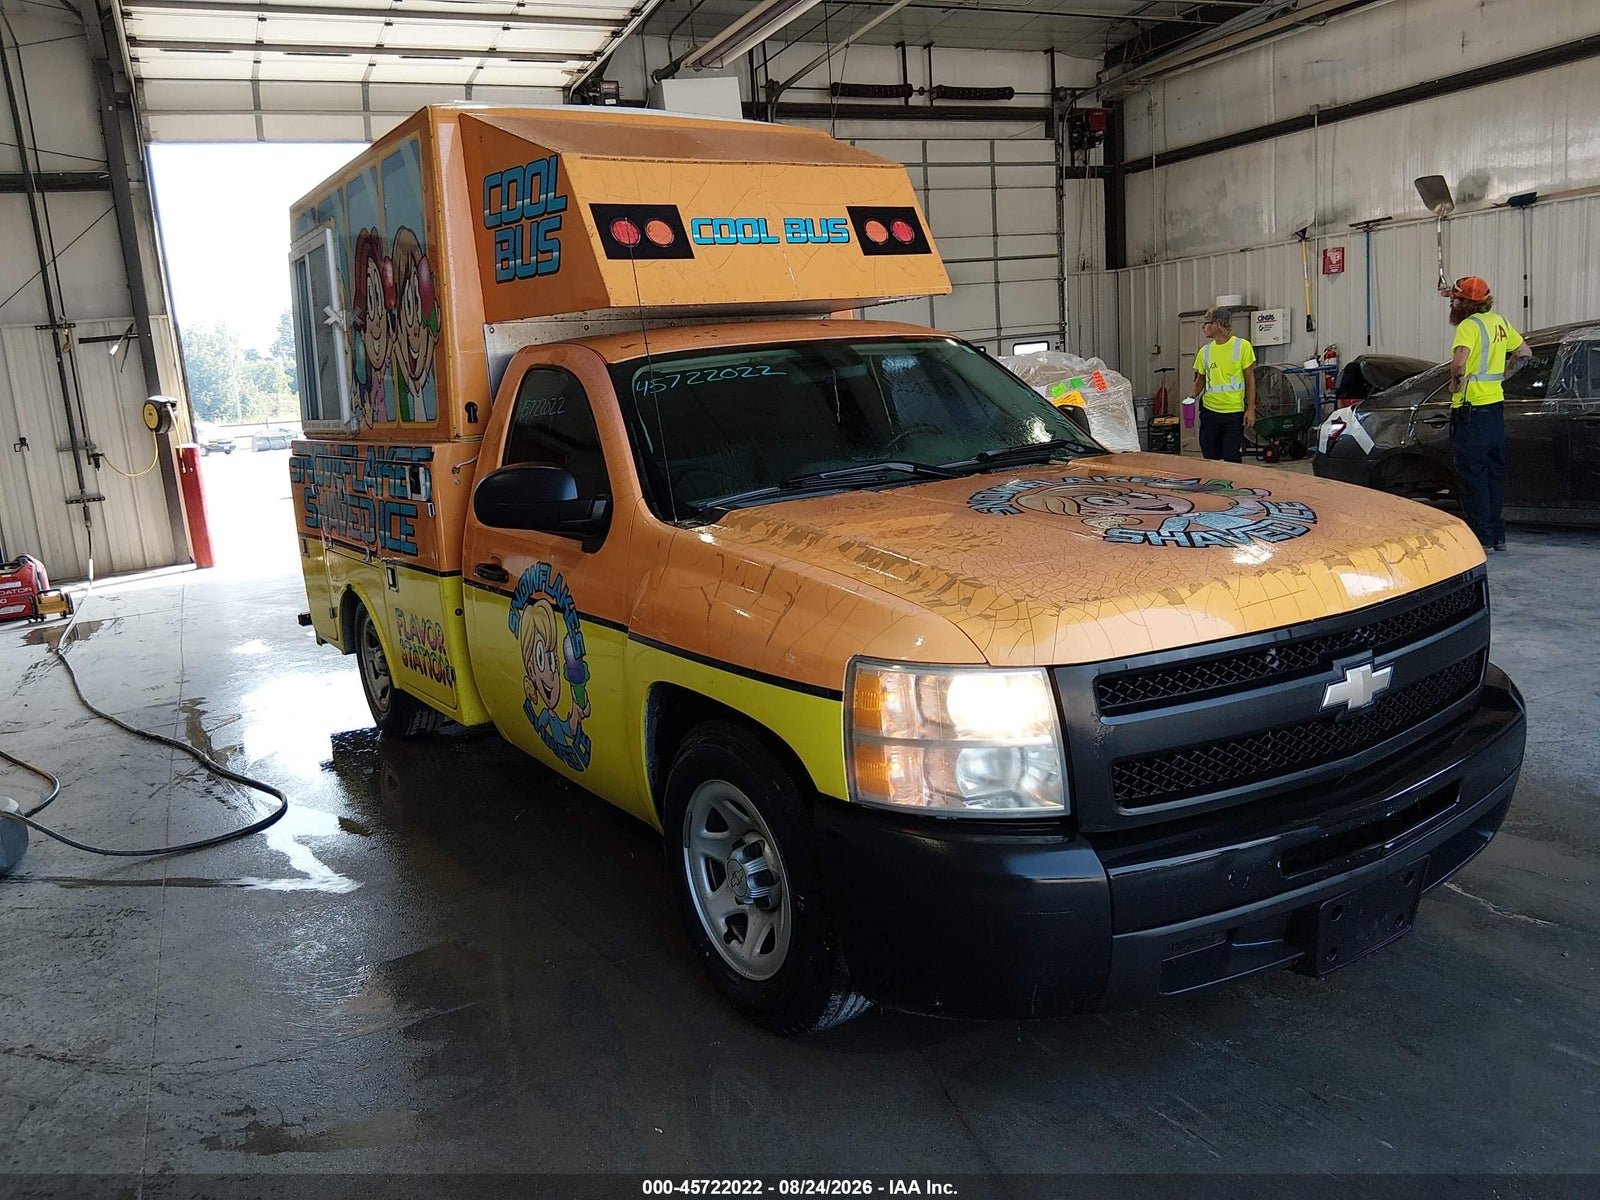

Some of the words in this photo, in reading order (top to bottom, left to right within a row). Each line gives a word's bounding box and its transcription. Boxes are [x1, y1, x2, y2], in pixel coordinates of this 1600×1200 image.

[482, 153, 569, 230] COOL
[494, 214, 563, 284] BUS
[690, 216, 781, 247] COOL
[783, 217, 851, 245] BUS
[635, 365, 788, 397] 45722022
[304, 487, 377, 546] SHAVED
[378, 501, 419, 558] ICE
[1103, 518, 1311, 548] SHAVED
[395, 607, 447, 655] FLAVOR
[508, 560, 587, 660] SNOWFLAKES
[400, 638, 456, 689] STATION
